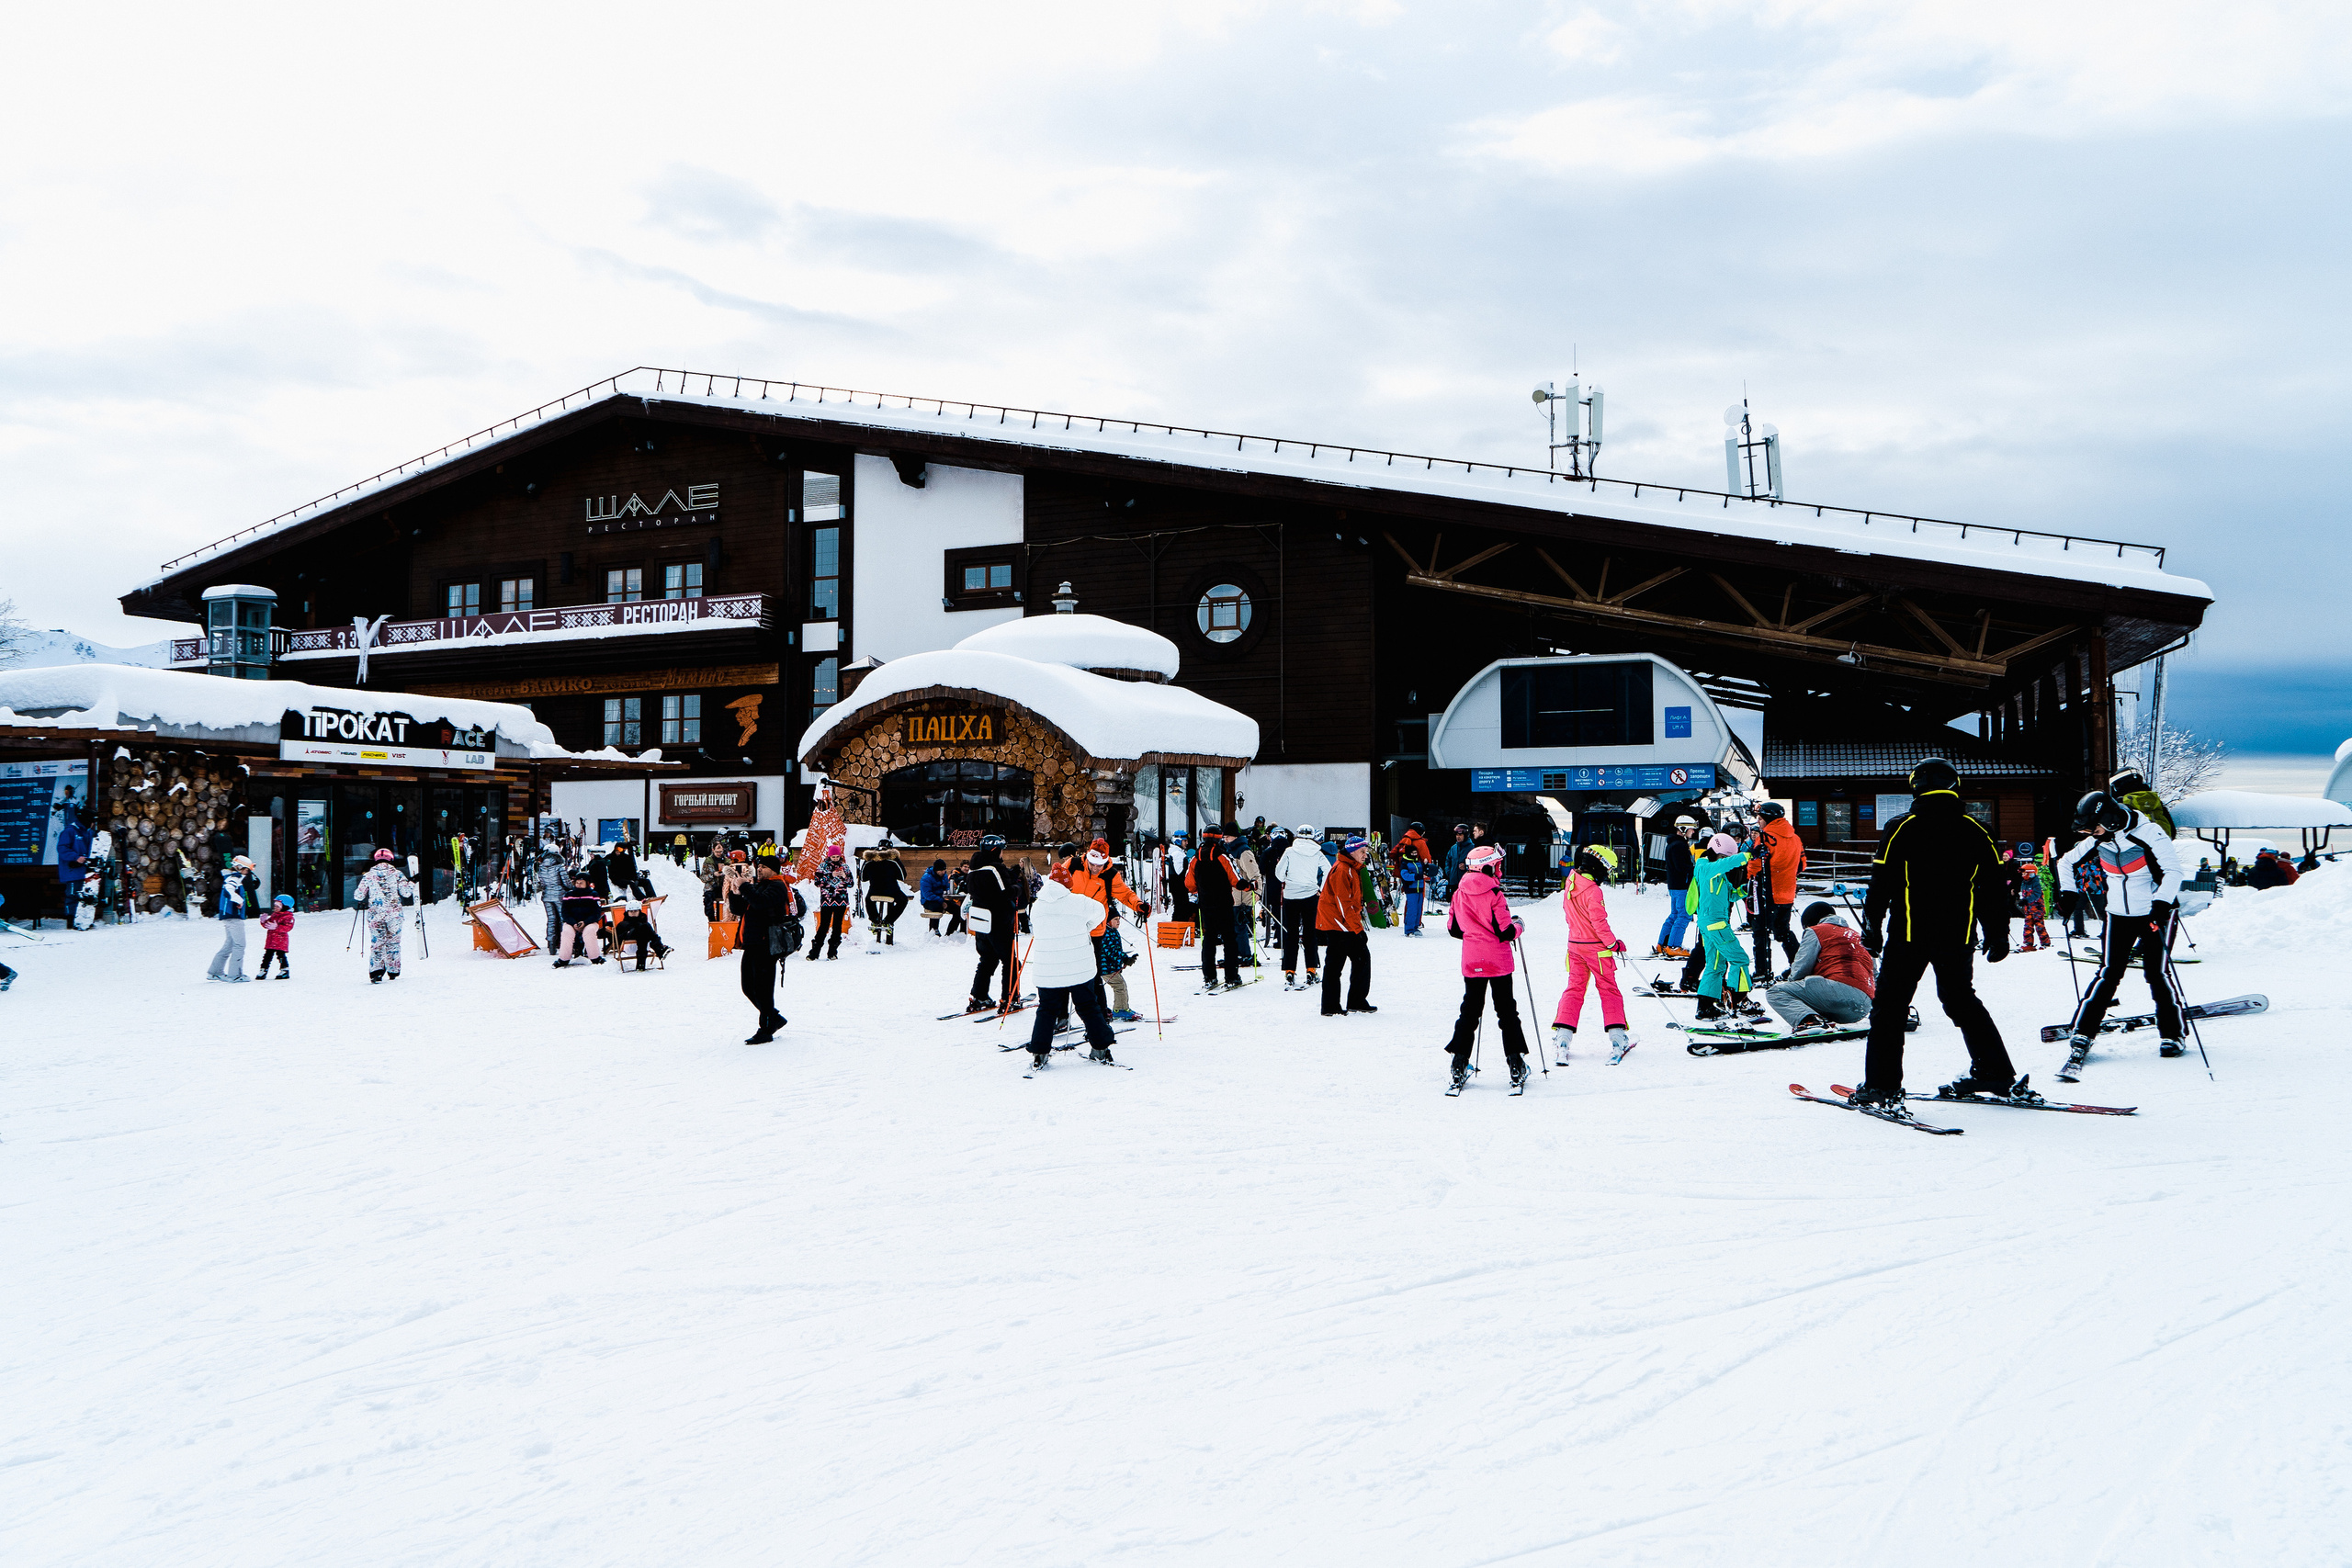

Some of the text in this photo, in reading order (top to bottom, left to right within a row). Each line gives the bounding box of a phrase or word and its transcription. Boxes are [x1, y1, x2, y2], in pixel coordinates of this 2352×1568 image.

[585, 483, 718, 522] ШАЛЕ
[588, 513, 716, 534] РЕСТОРАН
[623, 602, 699, 625] РЕСТОРАН
[304, 711, 410, 742] ПРОКАТ
[909, 715, 992, 743] ПАЦХА
[441, 728, 486, 747] RACE
[466, 754, 485, 764] LAB
[674, 793, 738, 806] ГОРНЫЙ ПРИЮТ
[948, 829, 985, 840] APEROL
[952, 838, 978, 847] SPRITZ
